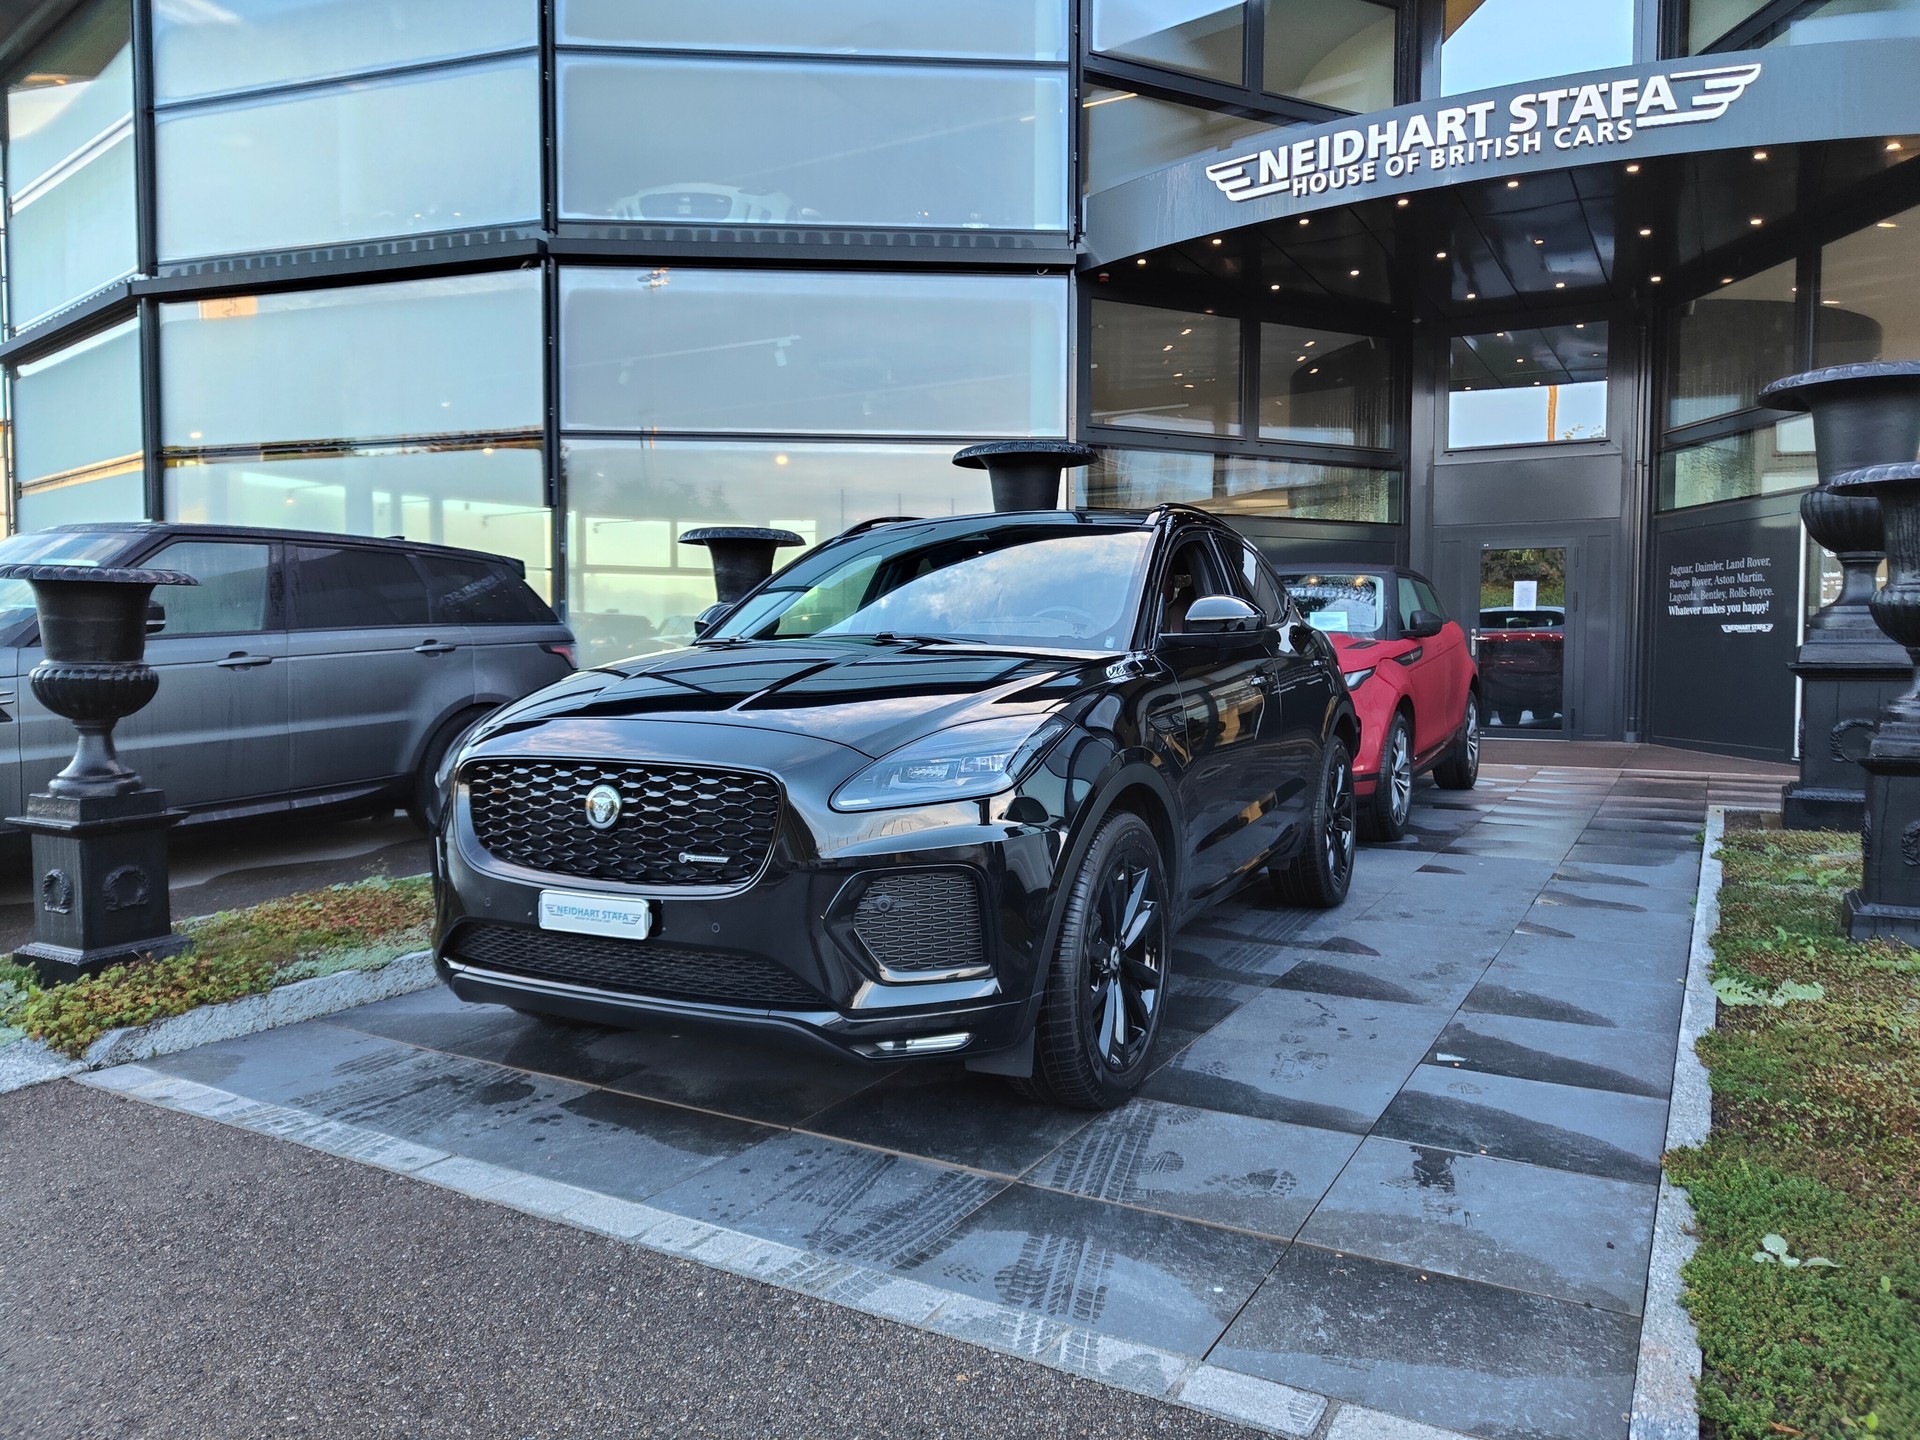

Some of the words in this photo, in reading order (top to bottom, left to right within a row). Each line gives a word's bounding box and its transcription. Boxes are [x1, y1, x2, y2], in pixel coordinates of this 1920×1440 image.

[1257, 100, 1497, 182] NEIDHART
[1509, 75, 1678, 134] STÄFA
[1291, 163, 1376, 198] HOUSE
[1385, 152, 1421, 179] OF
[1430, 131, 1542, 170] BRITISH
[1553, 119, 1634, 150] CARS
[1669, 565, 1694, 577] Jaguar,
[1695, 560, 1724, 573] Daimler,
[1726, 557, 1745, 570] Land
[1746, 556, 1771, 568] Rover,
[1669, 577, 1690, 590] Range
[1691, 576, 1713, 587] Rover,
[1714, 574, 1735, 585] Aston
[1736, 571, 1765, 583] Martin,
[1669, 591, 1699, 604] Lagonda,
[1700, 588, 1728, 601] Bentley,
[1729, 586, 1774, 599] Rolls-Royce.
[1668, 604, 1701, 616] Whatever
[1702, 603, 1726, 615] makes
[1726, 604, 1741, 616] you
[1742, 600, 1769, 615] happy!
[556, 905, 601, 918] NEIDHART
[601, 909, 629, 922] STÄFA
